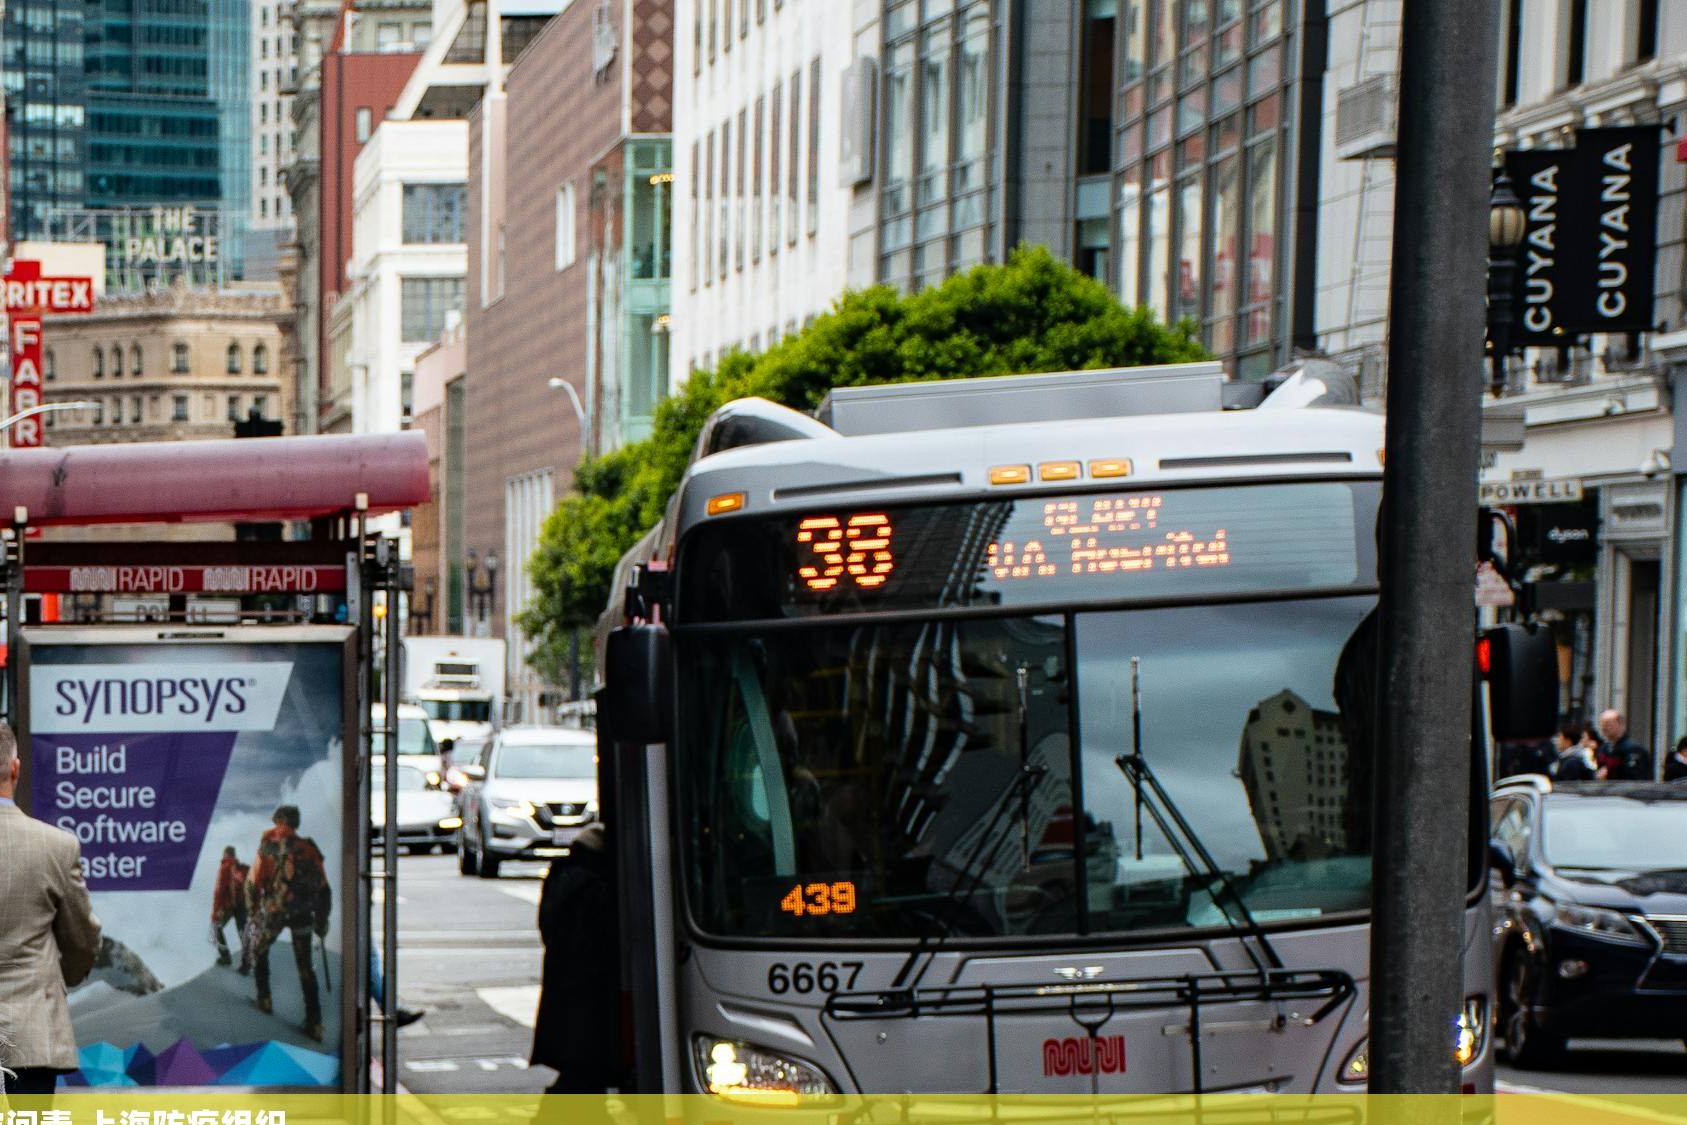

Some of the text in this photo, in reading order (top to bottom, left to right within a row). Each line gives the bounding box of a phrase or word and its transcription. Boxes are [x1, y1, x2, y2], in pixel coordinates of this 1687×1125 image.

[152, 207, 195, 232] THE
[1597, 143, 1632, 318] CUYANA
[127, 236, 217, 262] PALACE
[1524, 165, 1559, 332] CUYANA
[14, 321, 41, 446] FABR
[1480, 481, 1576, 498] POWELL
[1546, 526, 1589, 544] dyson
[797, 514, 893, 589] 38
[120, 567, 184, 591] RAPID
[252, 566, 318, 591] RAPID
[55, 677, 247, 724] SYNOPSYS
[56, 744, 127, 774] Build
[55, 781, 156, 809] Secure
[80, 852, 147, 877] aster
[780, 881, 857, 917] 439
[767, 961, 865, 994] 6667
[1042, 1035, 1127, 1077] MUNI
